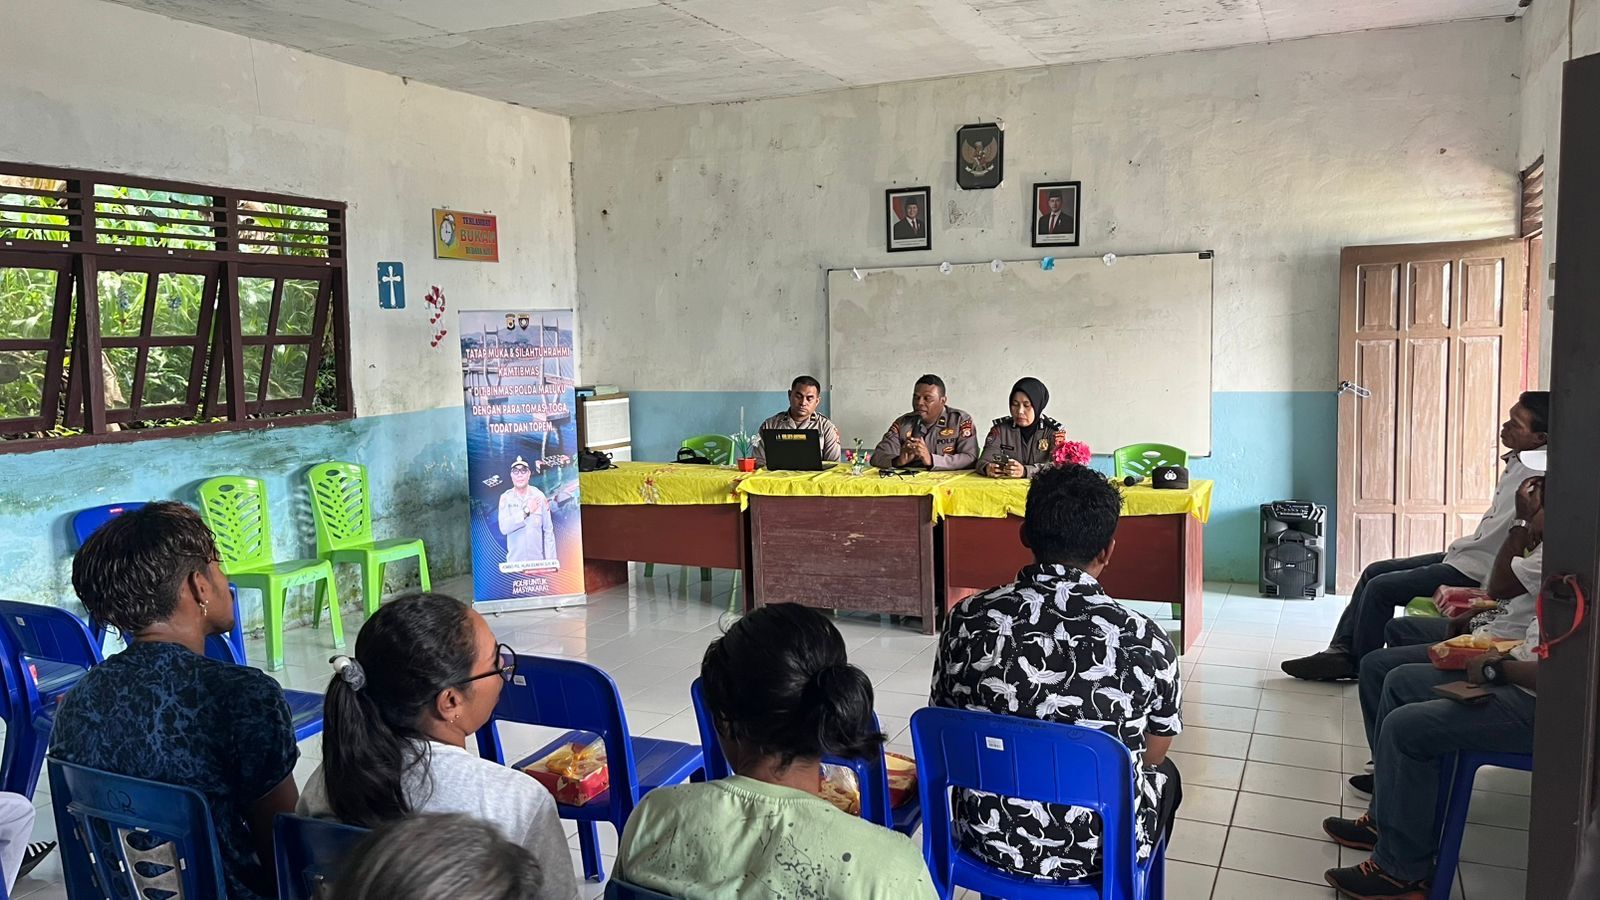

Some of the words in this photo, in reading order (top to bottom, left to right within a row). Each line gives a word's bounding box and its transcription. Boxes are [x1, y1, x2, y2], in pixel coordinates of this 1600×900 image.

[466, 348, 487, 359] TATAP
[489, 348, 509, 358] MUKA
[510, 348, 514, 357] &
[515, 347, 570, 358] SILAHTUHRAHMI
[498, 366, 540, 377] KAMTIBMAS
[514, 385, 537, 395] POLDA
[539, 384, 565, 395] MALUKU
[473, 405, 501, 415] DENGAN
[503, 404, 520, 414] PARA
[489, 423, 512, 433] TODAT
[514, 422, 528, 433] DAN
